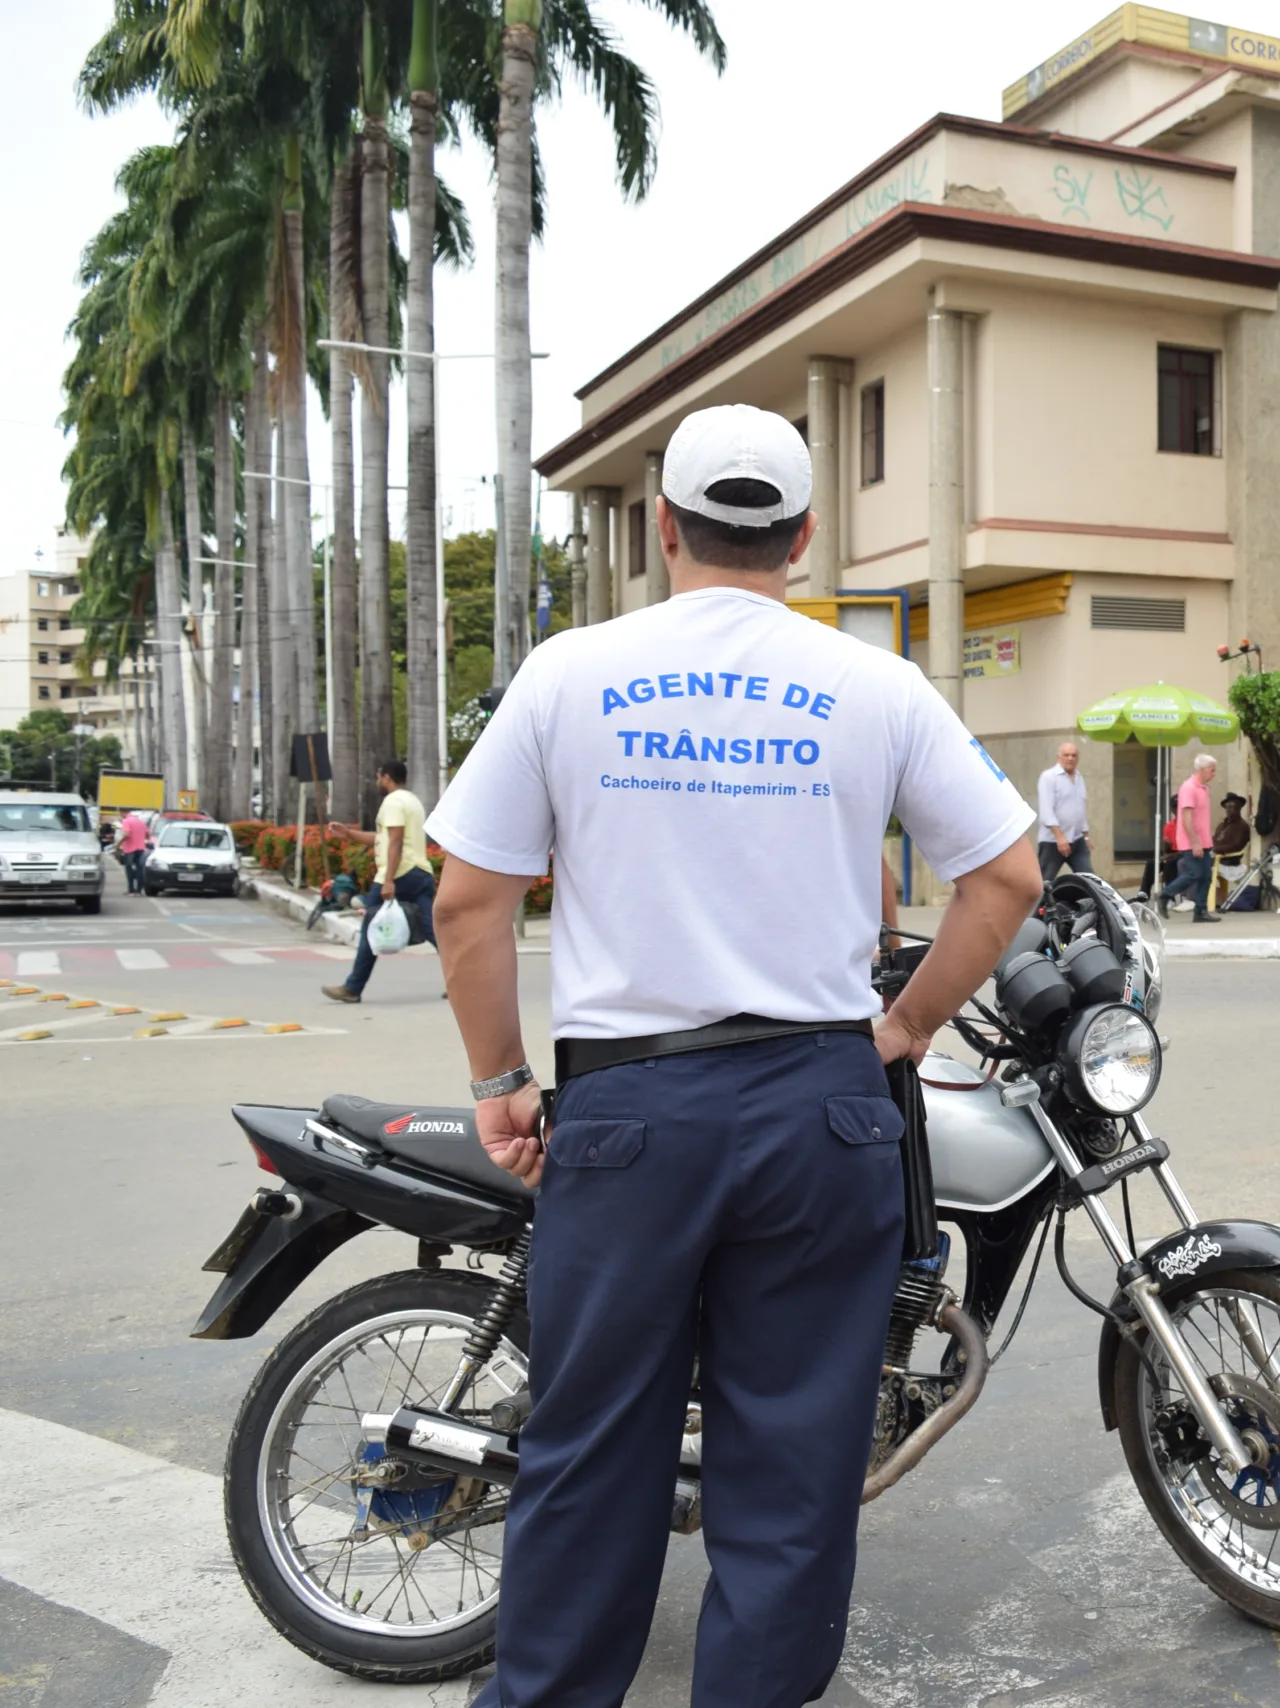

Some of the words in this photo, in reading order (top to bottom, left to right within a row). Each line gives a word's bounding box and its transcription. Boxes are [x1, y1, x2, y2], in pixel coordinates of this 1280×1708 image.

[602, 672, 769, 717] AGENTE
[781, 682, 837, 721] DE
[616, 728, 821, 766] TRÂNSITO
[600, 774, 682, 792] Cachoeiro
[686, 779, 706, 793] de
[711, 780, 797, 798] Itapemirim
[811, 783, 831, 797] ES
[406, 1121, 465, 1134] HONDA
[1101, 1144, 1157, 1175] HONDA
